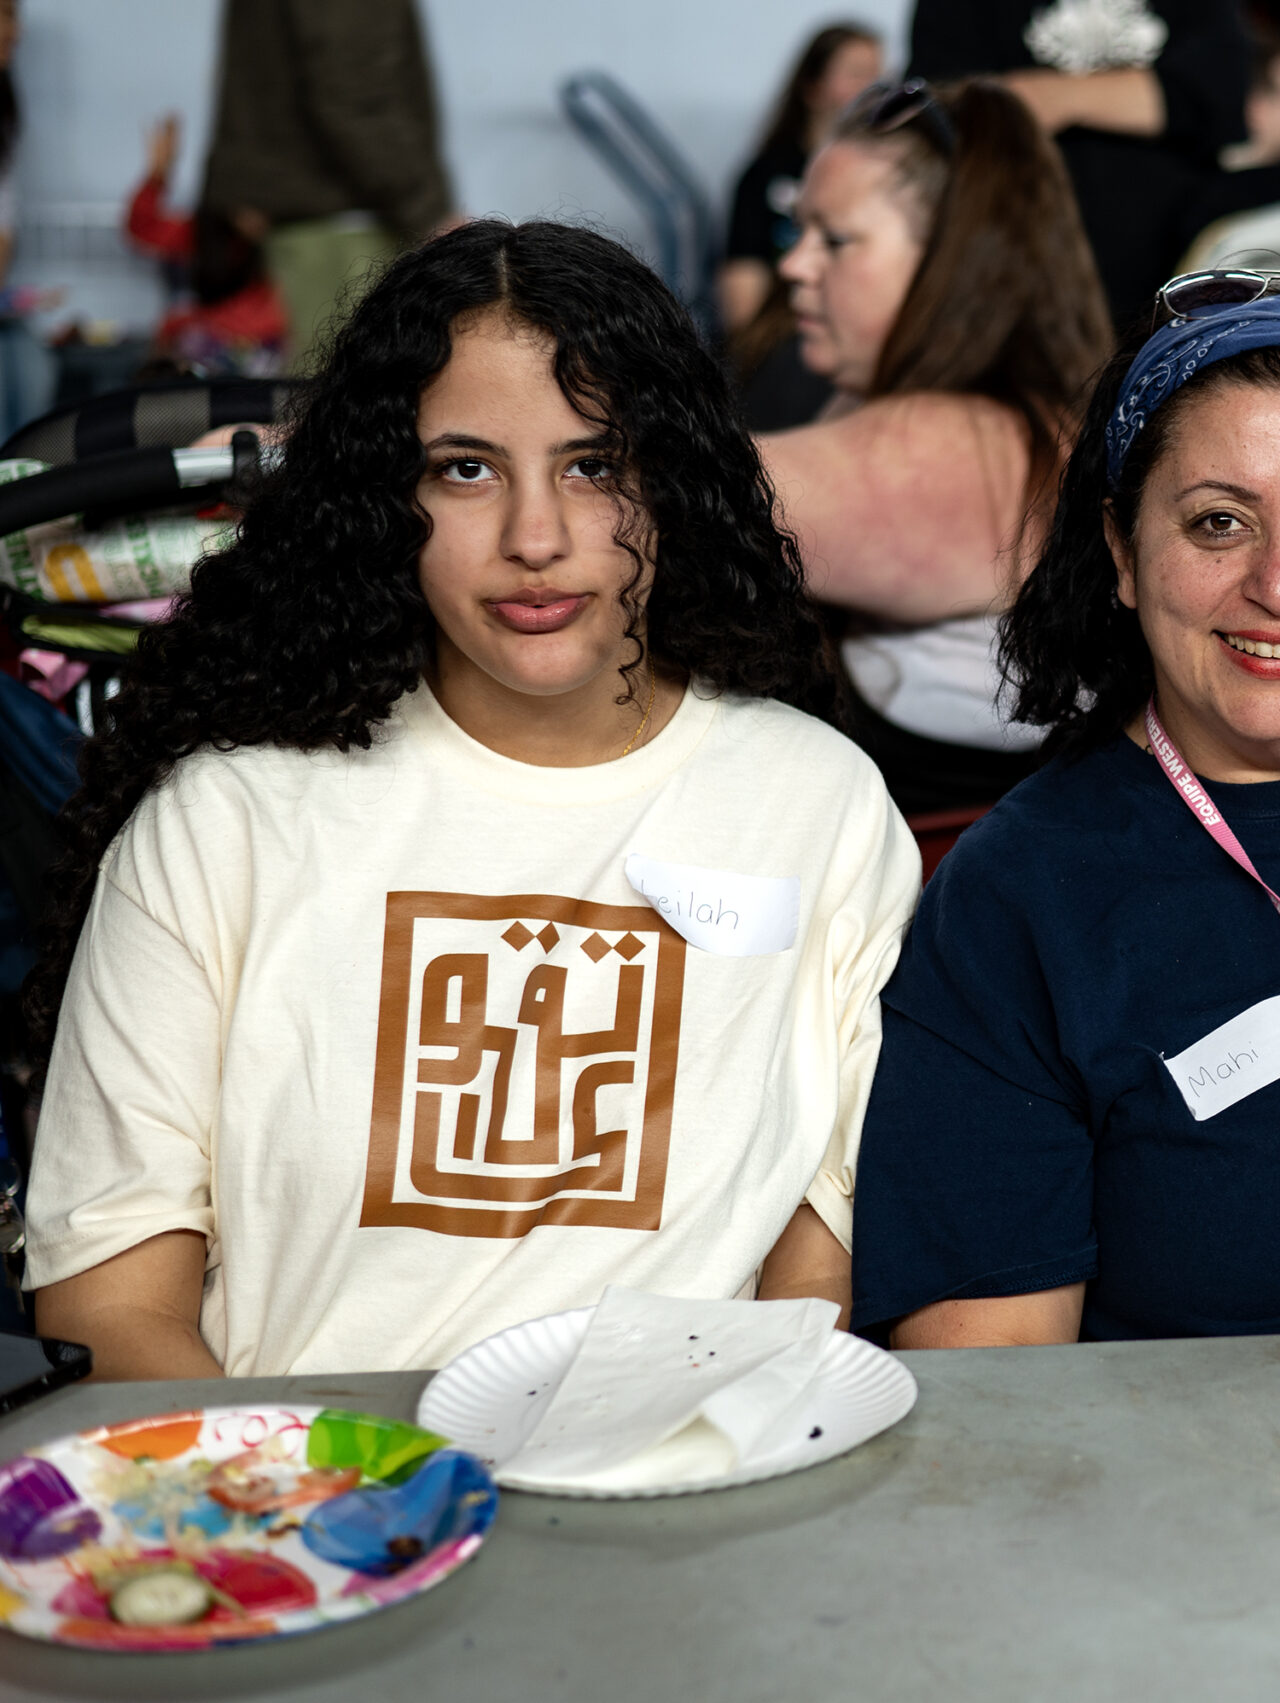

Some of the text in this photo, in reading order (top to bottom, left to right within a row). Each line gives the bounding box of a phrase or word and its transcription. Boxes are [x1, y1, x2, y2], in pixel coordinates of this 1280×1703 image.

[1146, 712, 1221, 826] ÉQUIPE WESTERN
[1188, 1040, 1259, 1098] Mahi
